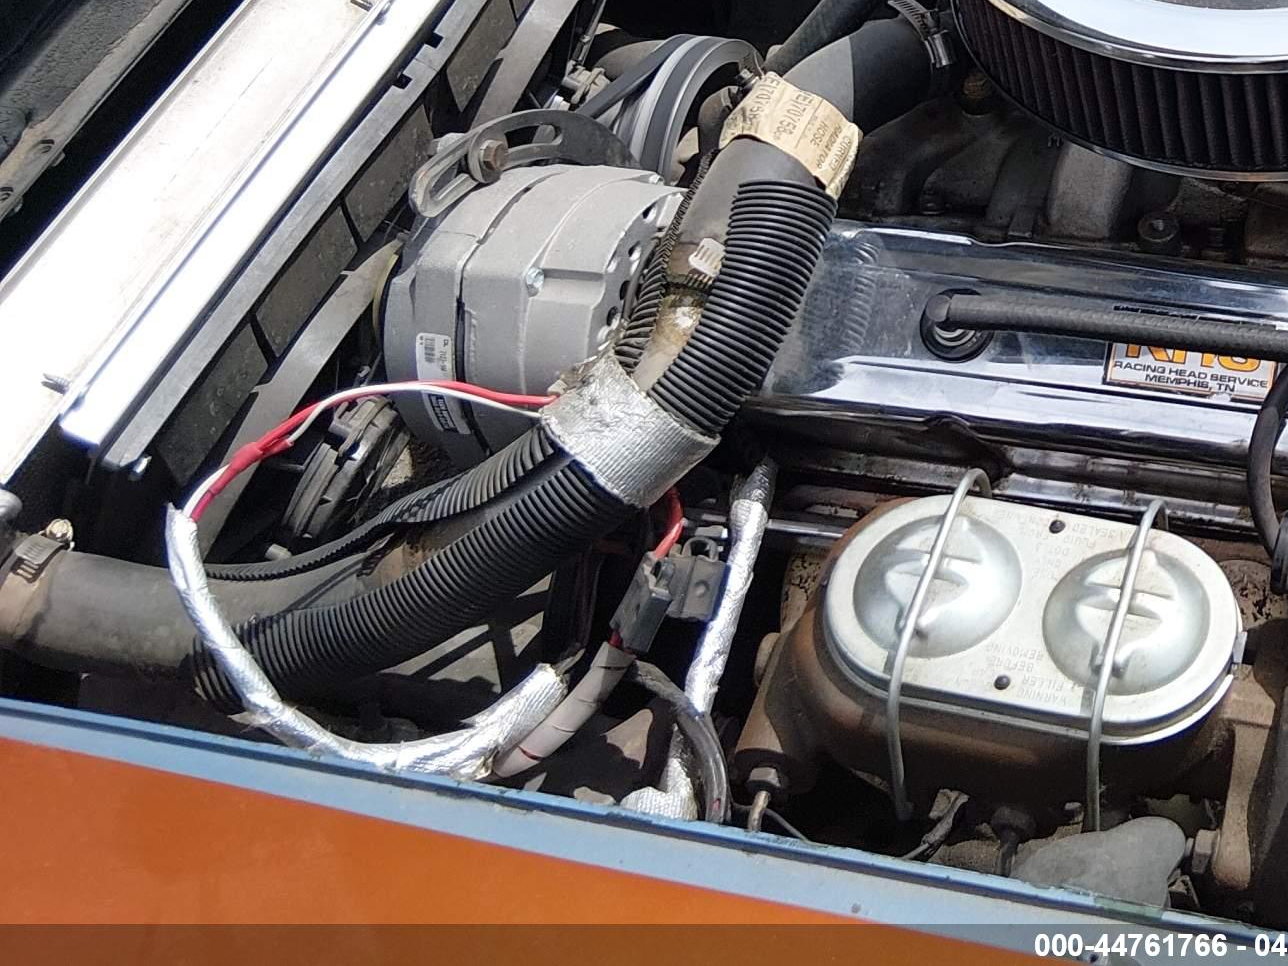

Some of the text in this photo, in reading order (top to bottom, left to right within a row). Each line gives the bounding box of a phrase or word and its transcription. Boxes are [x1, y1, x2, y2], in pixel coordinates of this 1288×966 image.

[809, 120, 829, 146] HOSE
[830, 135, 852, 172] CURVED
[1113, 361, 1268, 388] RACING HEAD SERVICE
[1145, 374, 1236, 393] MEMPHIS, TN
[985, 642, 1043, 661] REMOVING
[987, 655, 1034, 673] BEFORE
[1022, 675, 1064, 691] FILLER
[1017, 688, 1067, 705] WARNING
